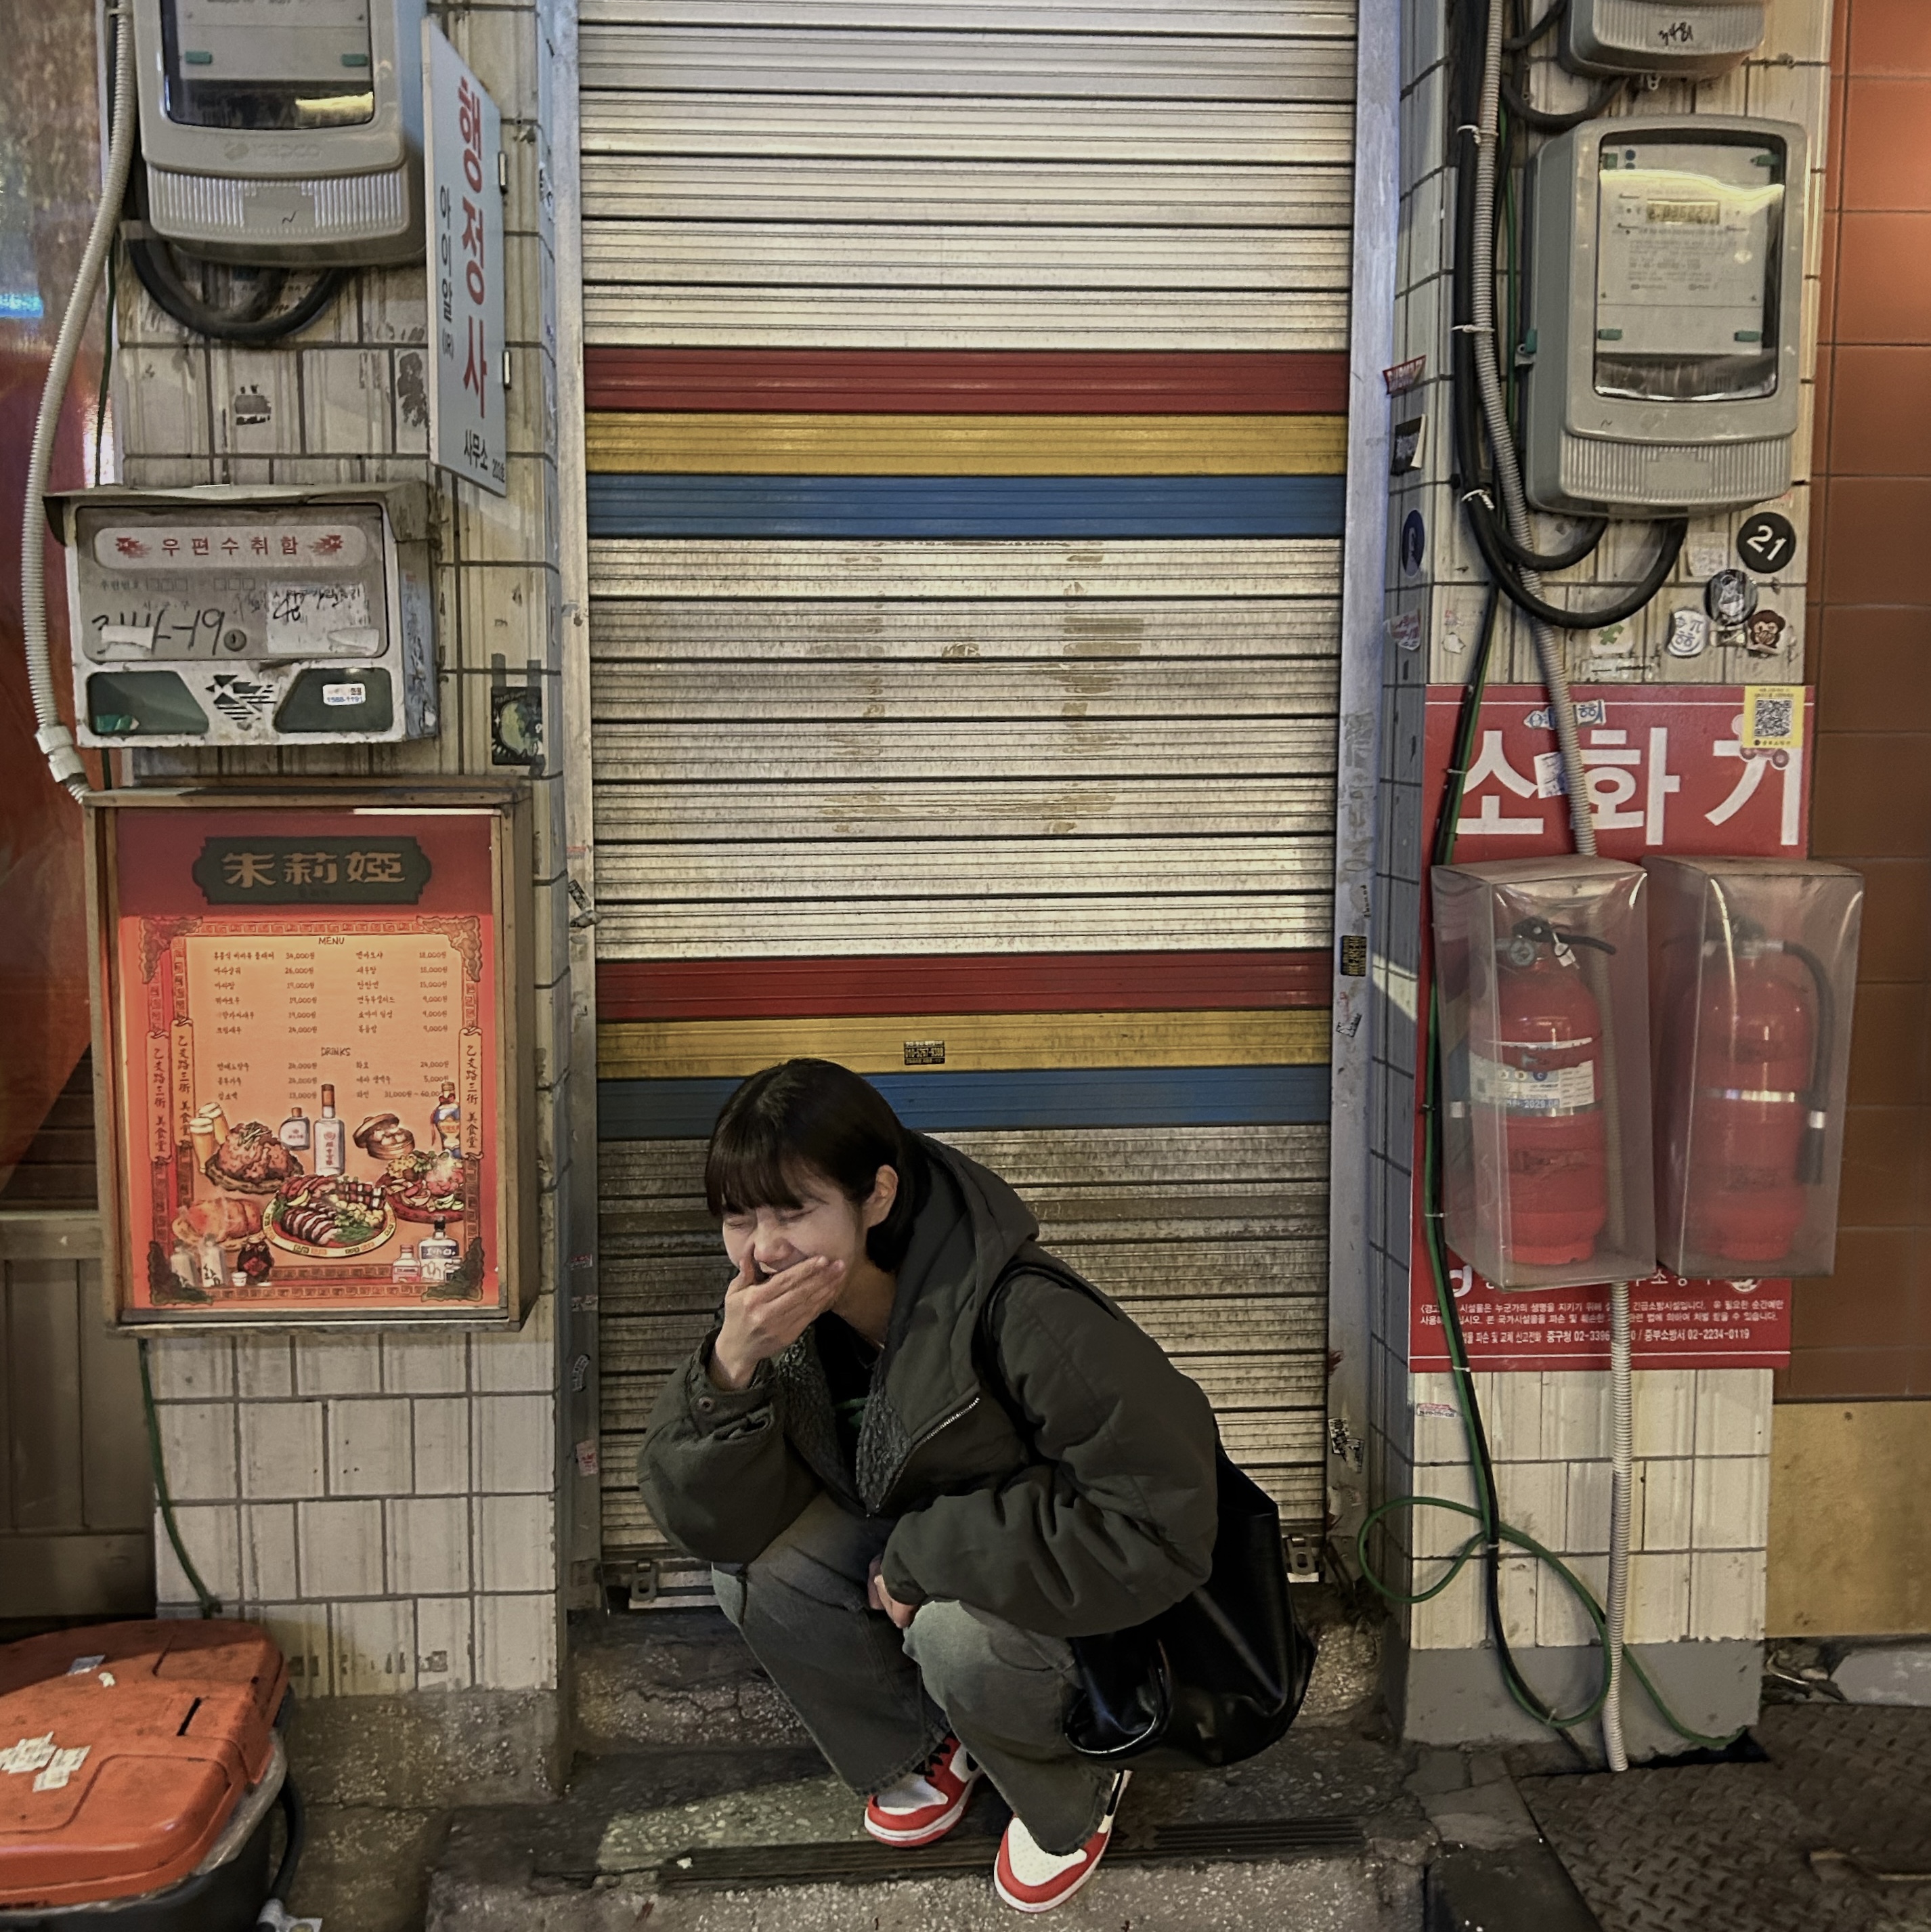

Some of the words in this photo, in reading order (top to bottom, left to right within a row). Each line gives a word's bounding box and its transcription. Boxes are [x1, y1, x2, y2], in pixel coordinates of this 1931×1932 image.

[458, 76, 487, 419] 행정사
[464, 429, 488, 471] 사무소
[162, 536, 298, 557] 우편수취함
[1746, 525, 1787, 561] 21
[1456, 727, 1802, 845] 소화기
[321, 1047, 351, 1056] DRINKS
[1495, 1304, 1527, 1313] 누군가의
[1559, 1302, 1582, 1312] 지키기
[1546, 1331, 1571, 1343] 중구청
[1645, 1329, 1685, 1341] 중부소방서
